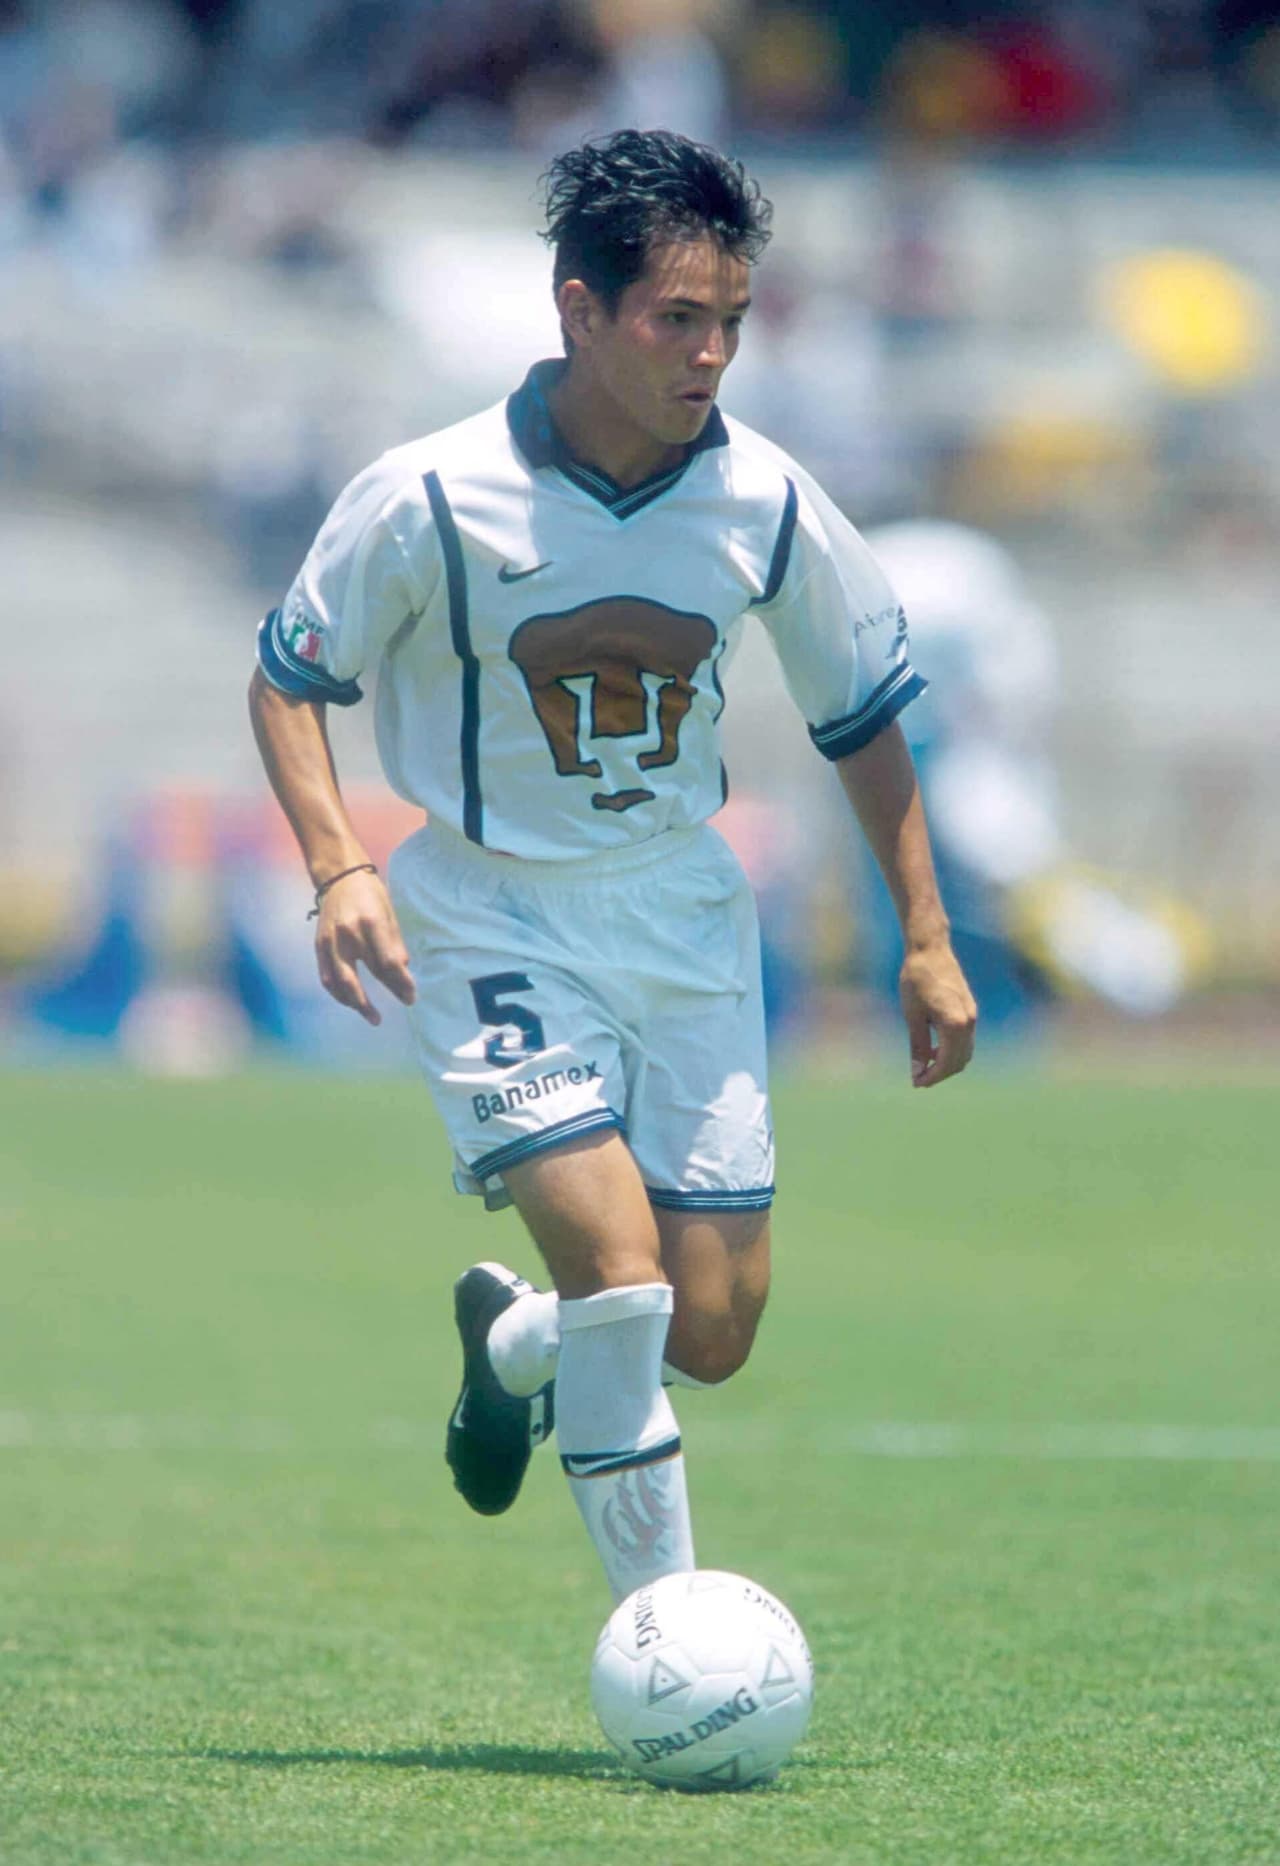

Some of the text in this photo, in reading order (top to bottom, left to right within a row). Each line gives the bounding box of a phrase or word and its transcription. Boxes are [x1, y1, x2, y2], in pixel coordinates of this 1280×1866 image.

[469, 971, 546, 1069] 5
[472, 1060, 603, 1124] Banamex
[631, 1687, 759, 1764] SPALDING
